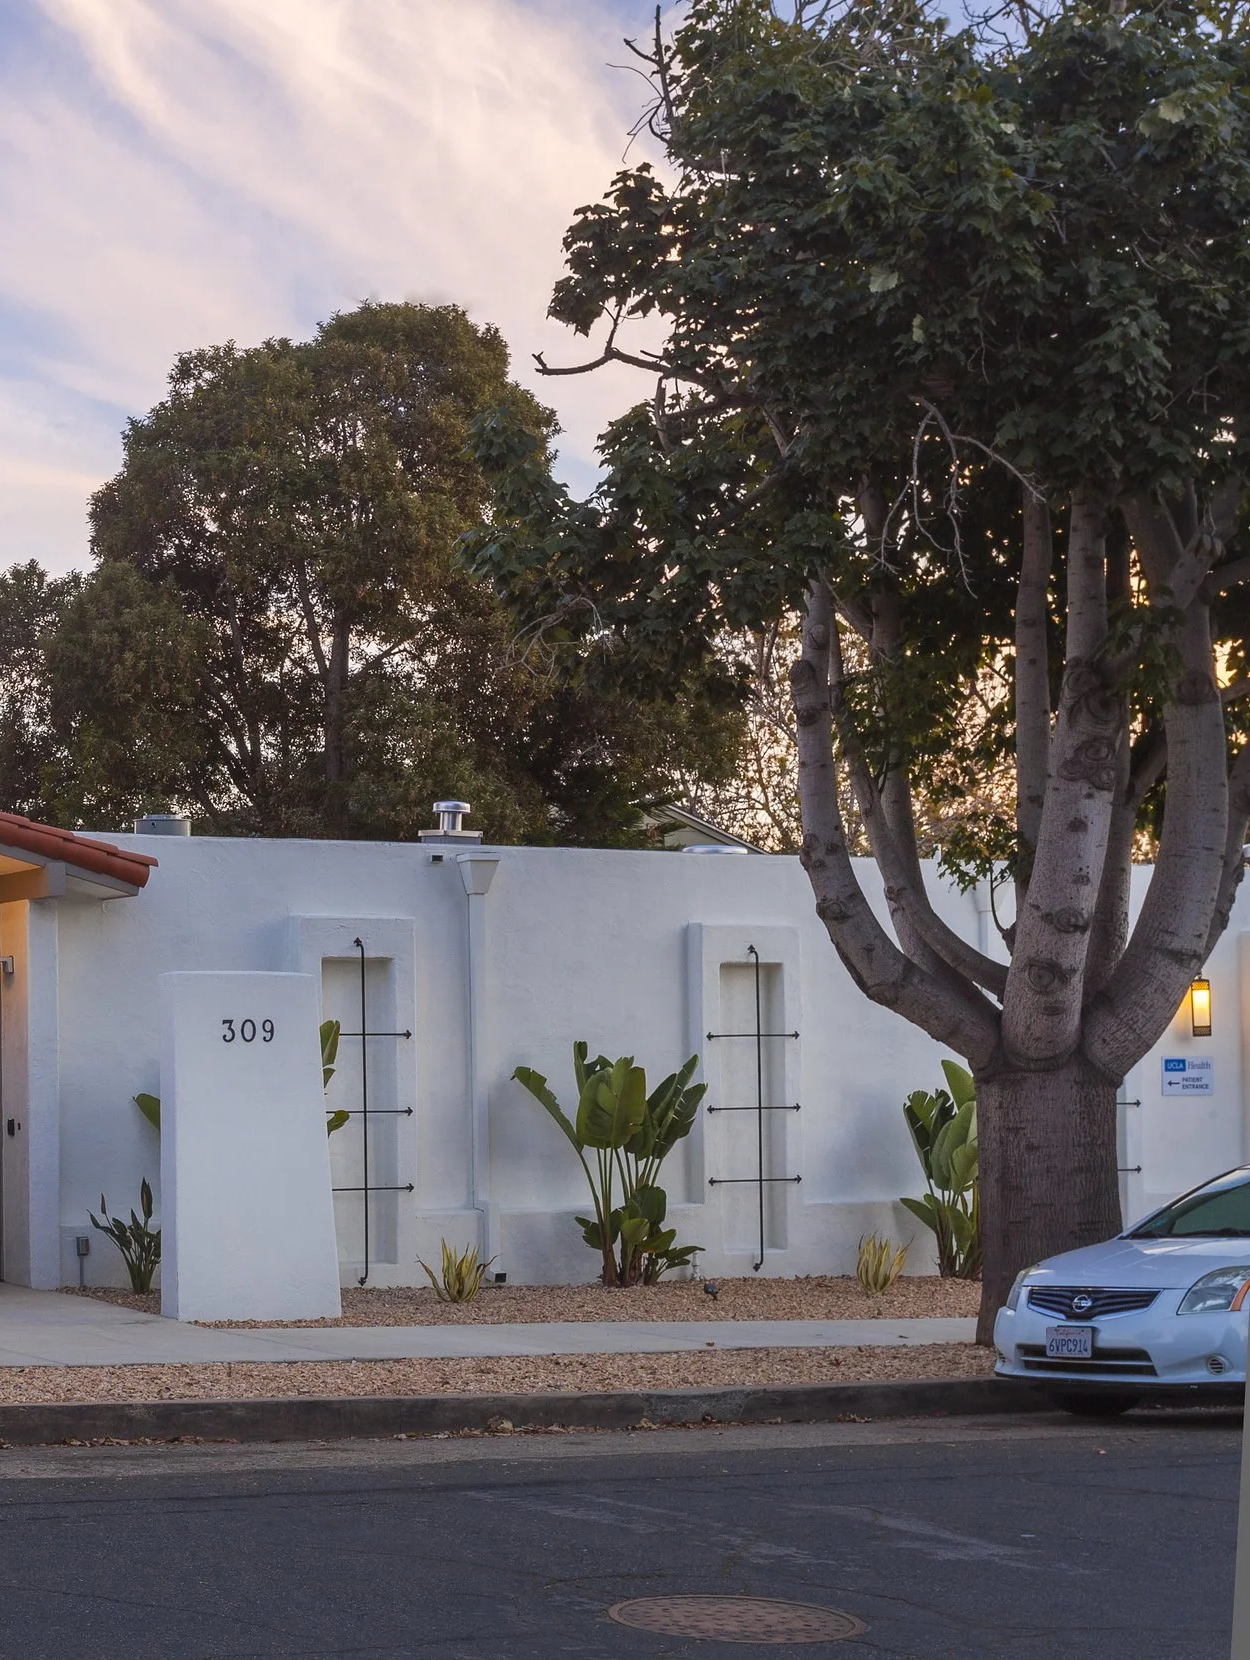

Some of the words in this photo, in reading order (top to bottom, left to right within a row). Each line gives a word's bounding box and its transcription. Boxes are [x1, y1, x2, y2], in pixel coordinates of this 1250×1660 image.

[222, 1018, 275, 1043] 309
[1166, 1061, 1184, 1069] UCLA
[1188, 1061, 1211, 1070] Health
[1049, 1338, 1088, 1353] 6VPC914
